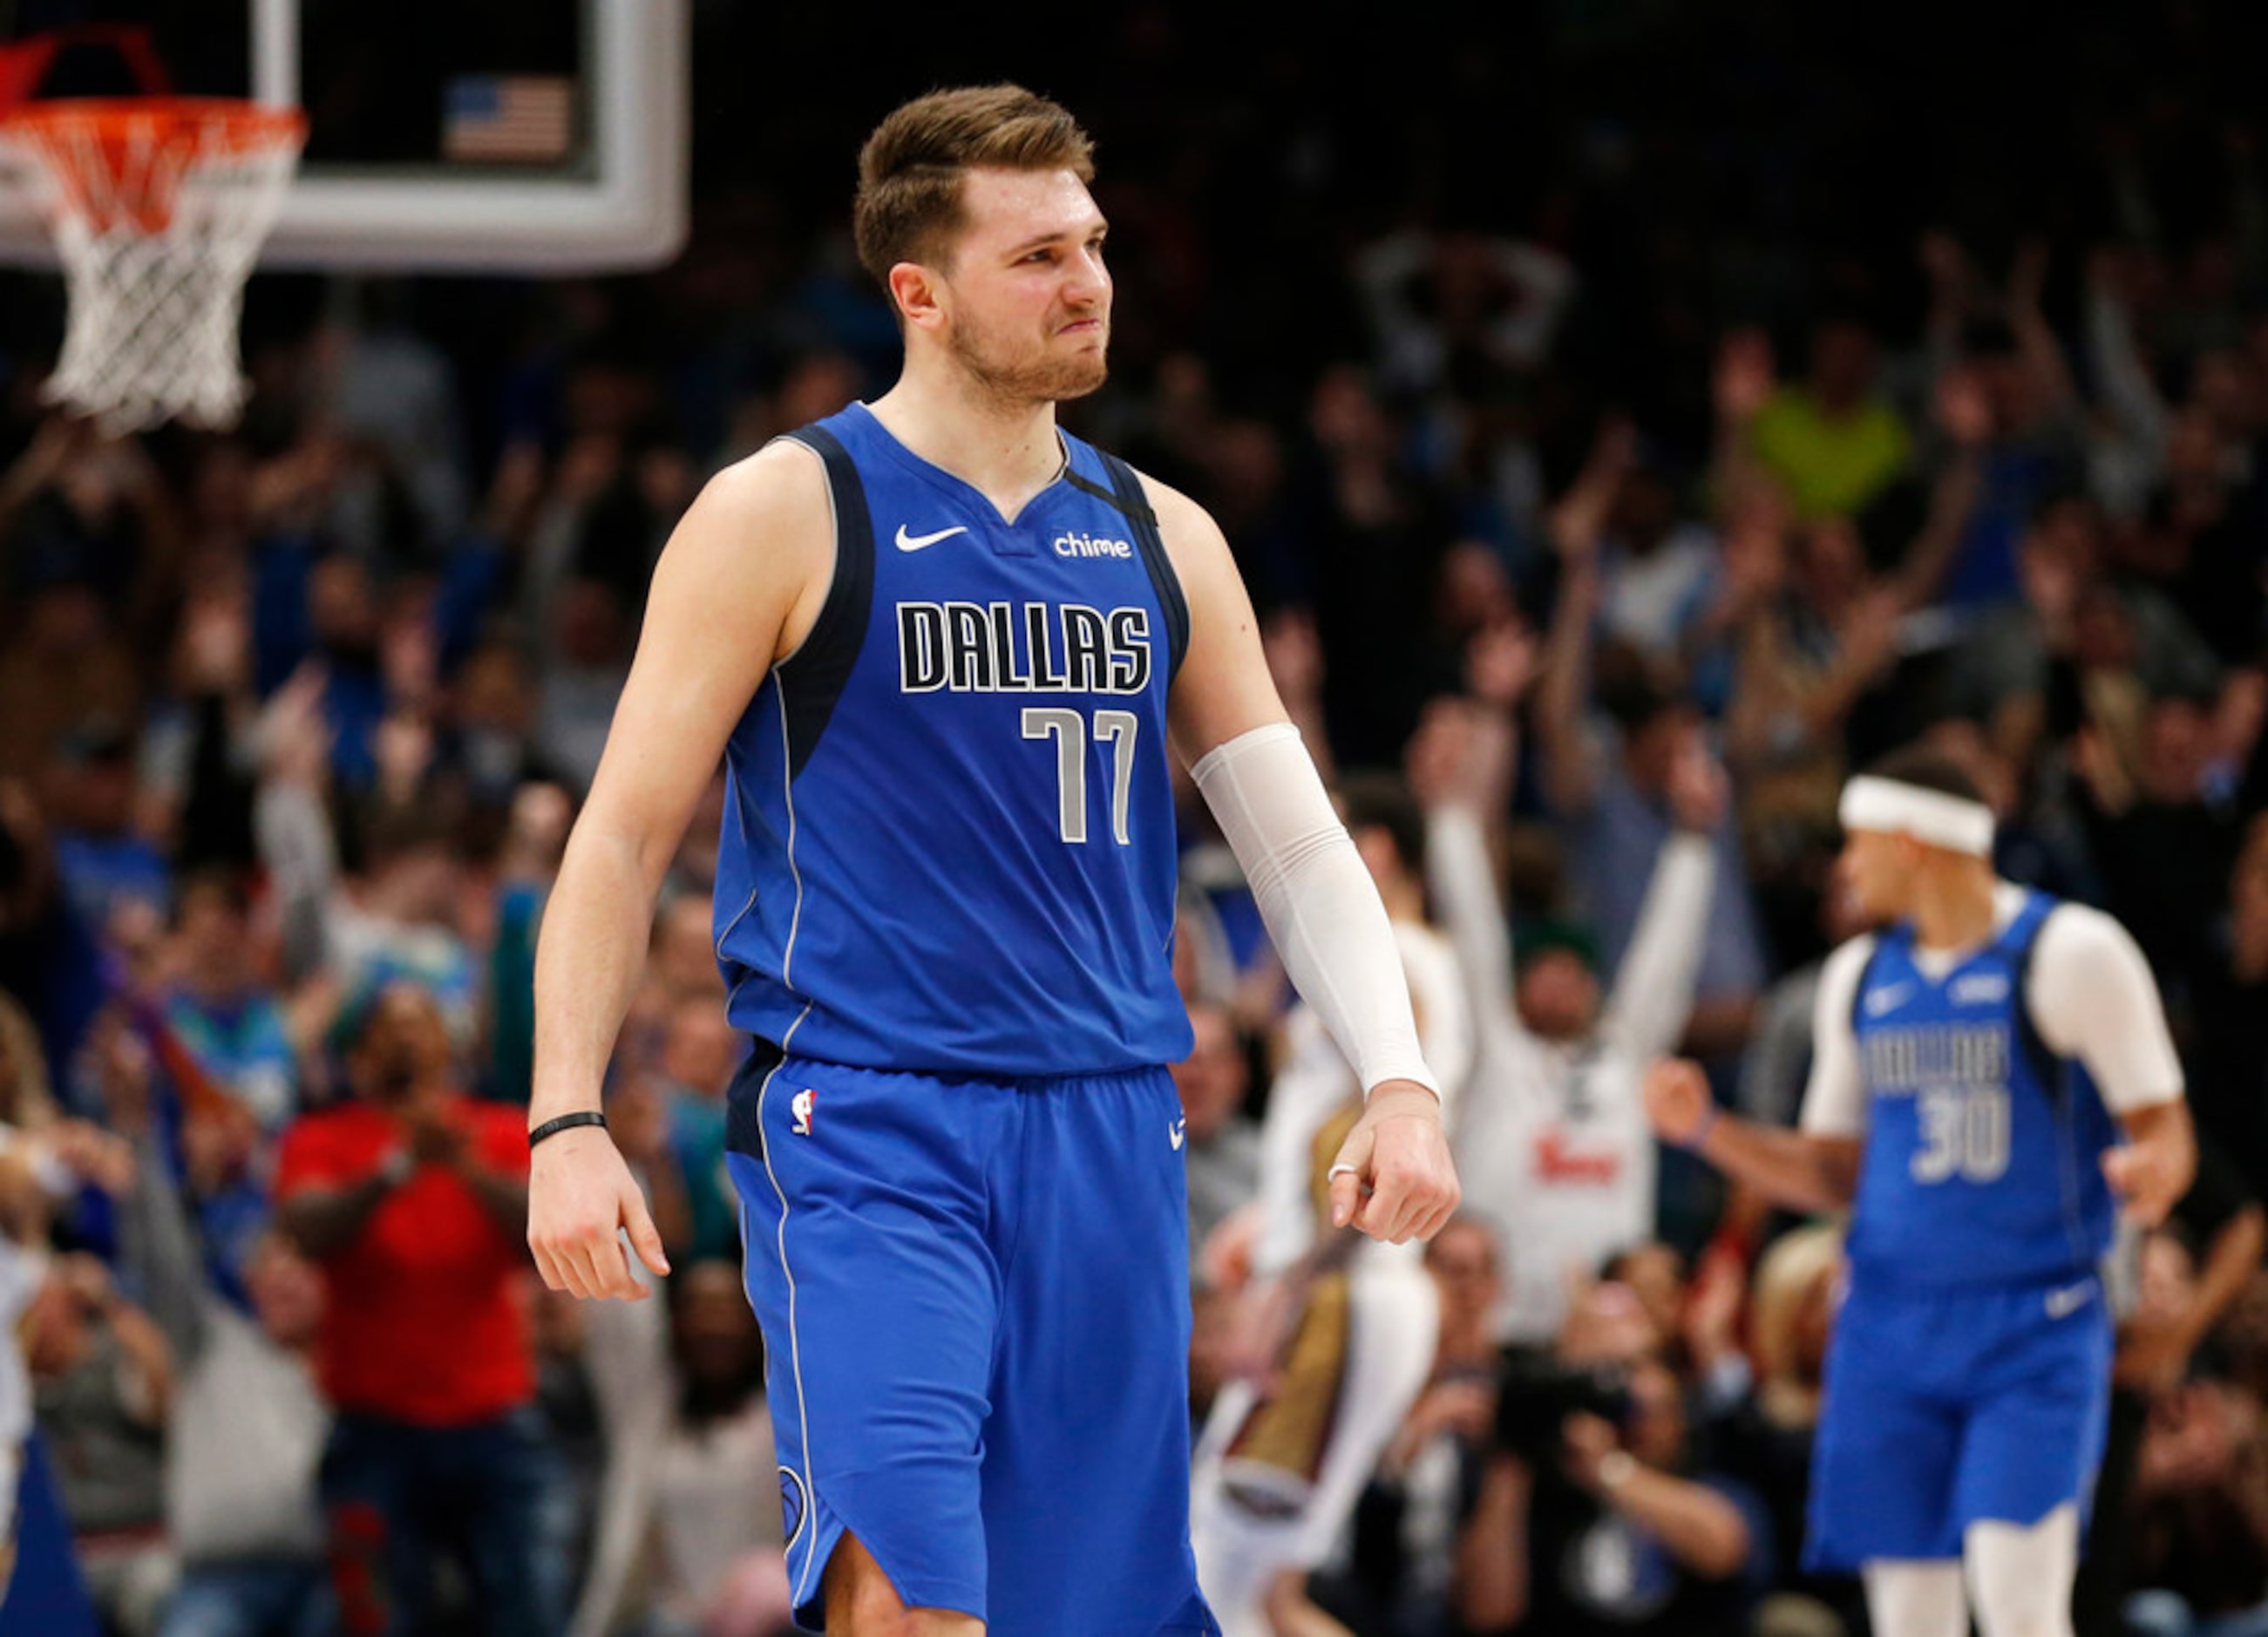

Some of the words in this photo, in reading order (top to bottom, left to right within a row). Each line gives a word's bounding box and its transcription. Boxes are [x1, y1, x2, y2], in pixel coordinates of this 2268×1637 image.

[1054, 532, 1132, 558] chime
[896, 601, 1151, 696] DALLAS
[1022, 707, 1138, 846] 77
[1911, 1087, 2012, 1184] 30
